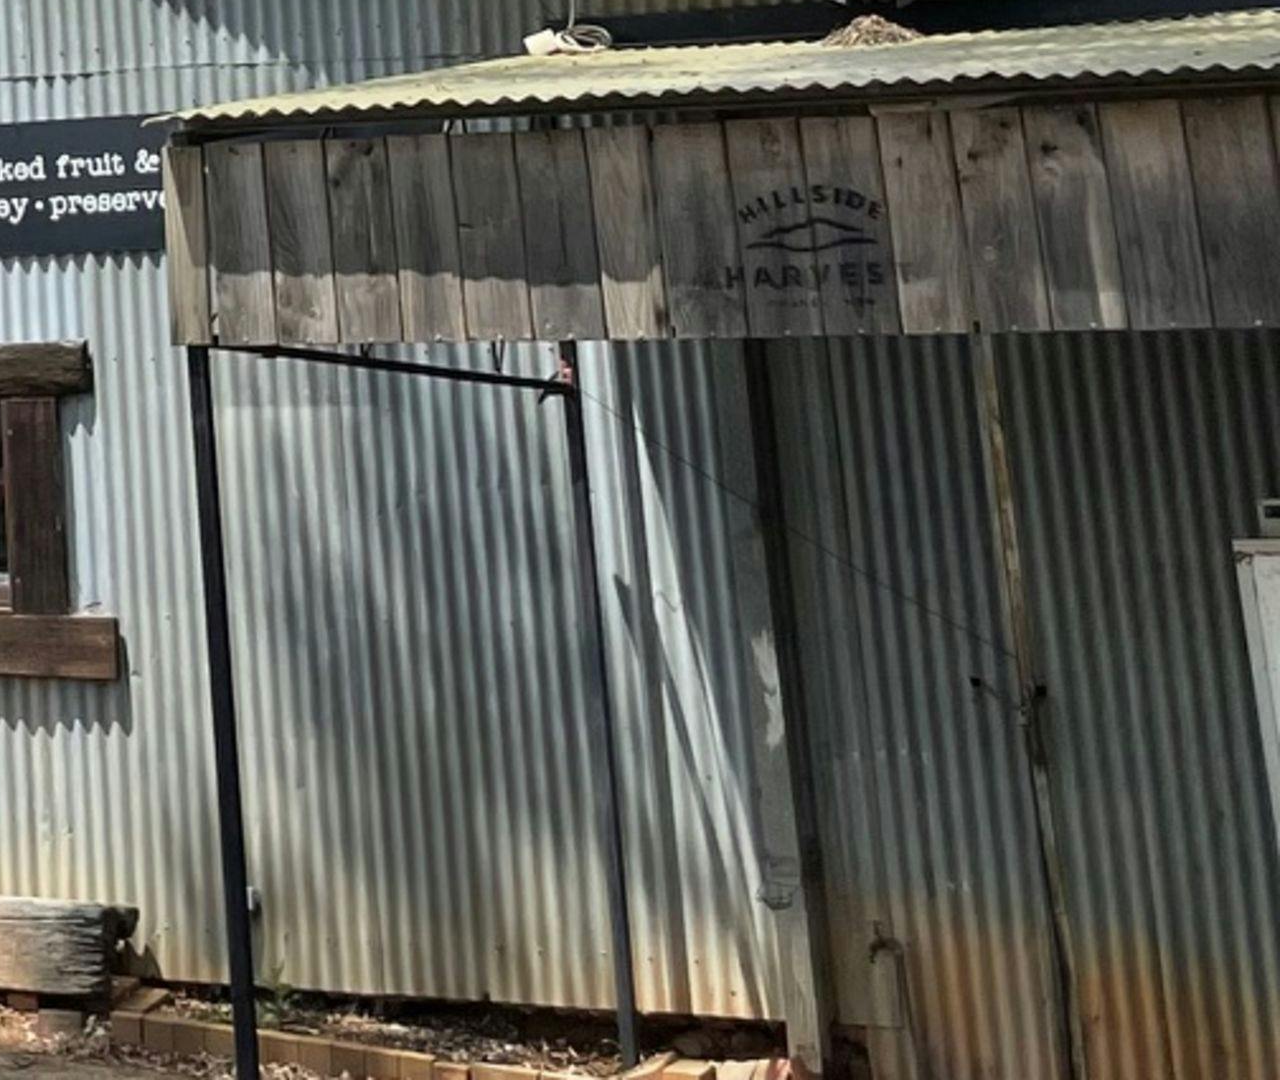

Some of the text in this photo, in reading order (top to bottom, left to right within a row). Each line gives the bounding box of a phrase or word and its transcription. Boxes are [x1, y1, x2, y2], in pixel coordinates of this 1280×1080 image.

[55, 151, 125, 179] fruit
[134, 148, 160, 174] &
[738, 184, 883, 223] HILLSIDE
